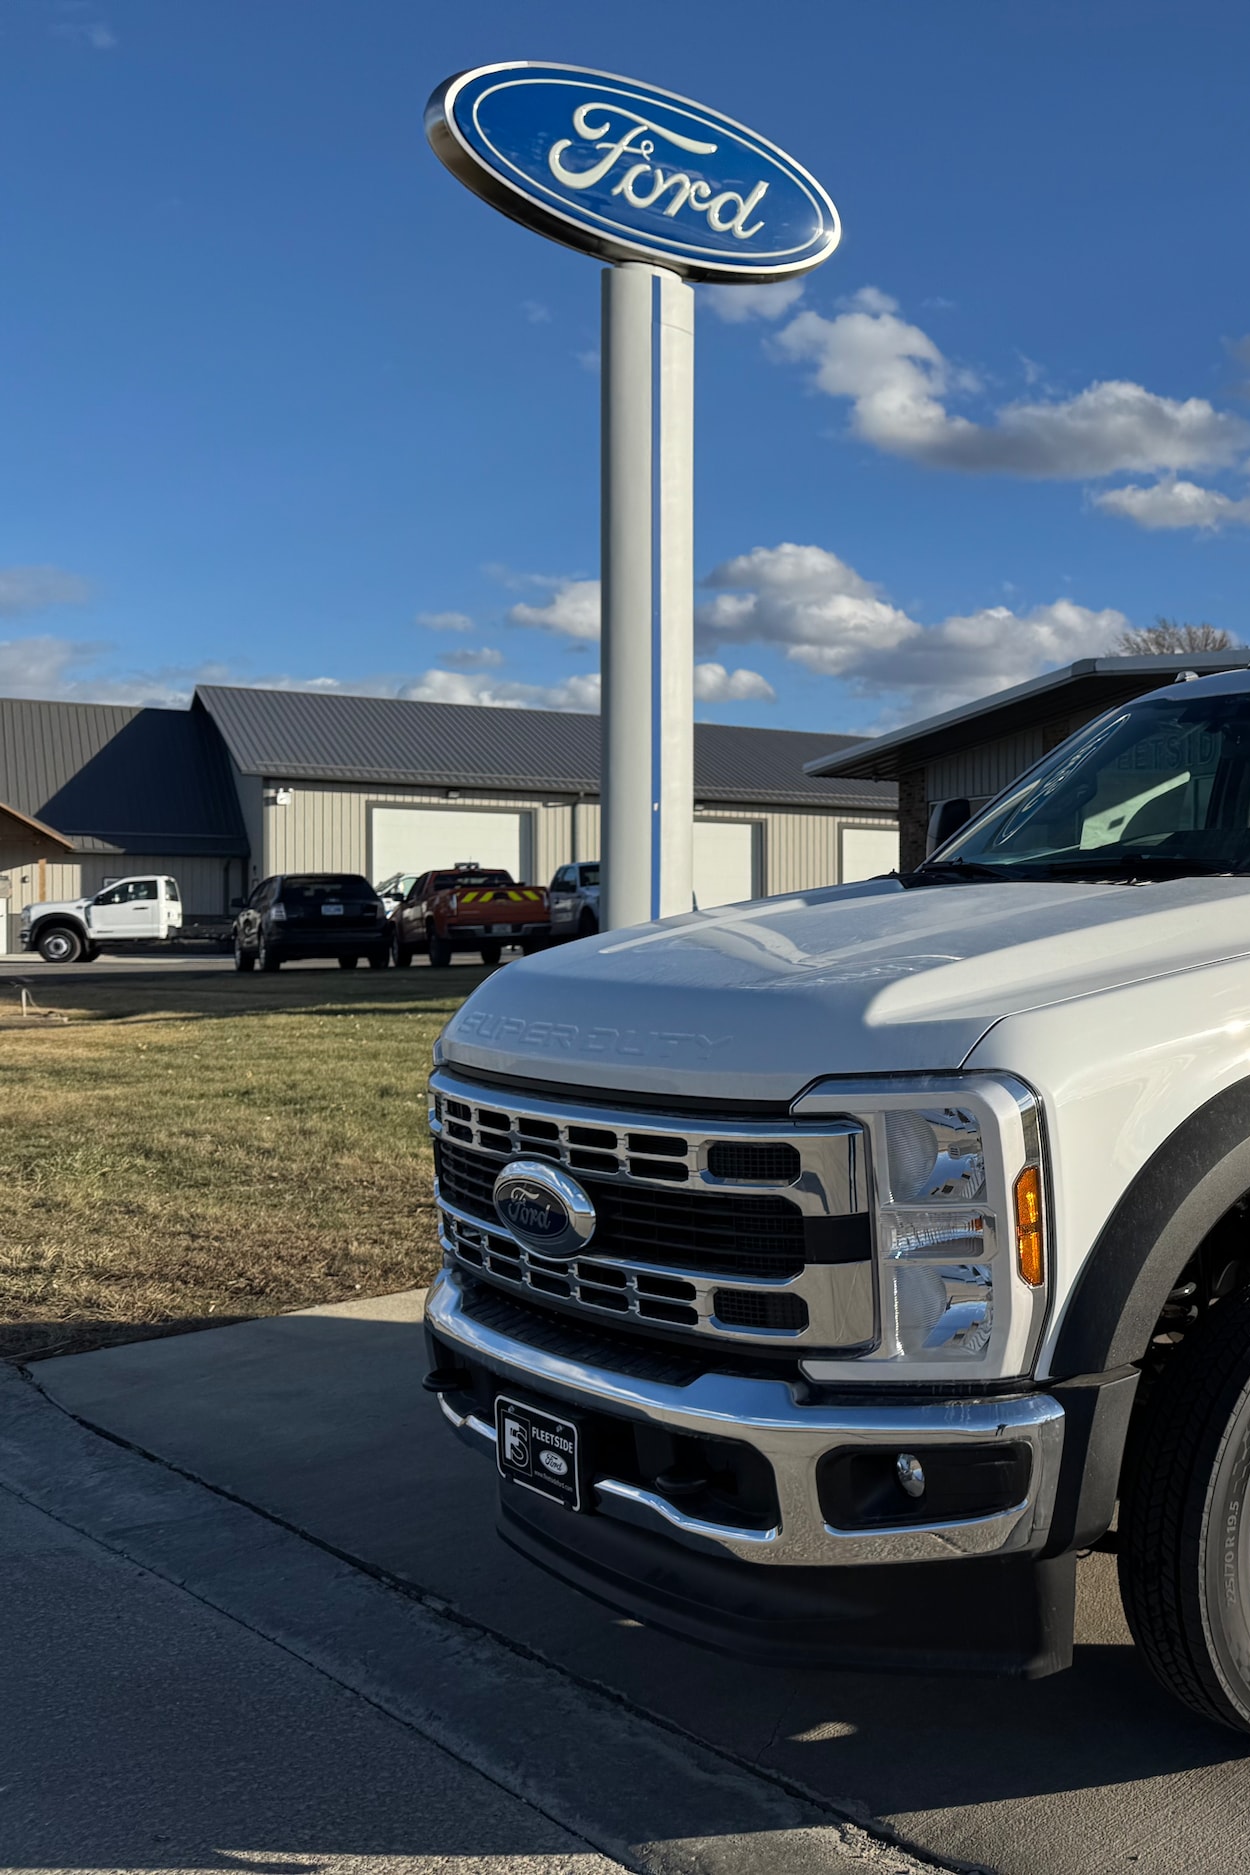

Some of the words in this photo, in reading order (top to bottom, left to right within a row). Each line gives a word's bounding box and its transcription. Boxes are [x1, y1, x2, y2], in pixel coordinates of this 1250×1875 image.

[548, 102, 770, 239] Ford
[1114, 732, 1217, 769] EETSID
[457, 1011, 579, 1049] SUPER
[507, 1186, 552, 1230] Ford
[532, 1426, 573, 1454] FLEETSIDE
[545, 1453, 563, 1471] Ford
[1226, 1501, 1240, 1534] 19.5
